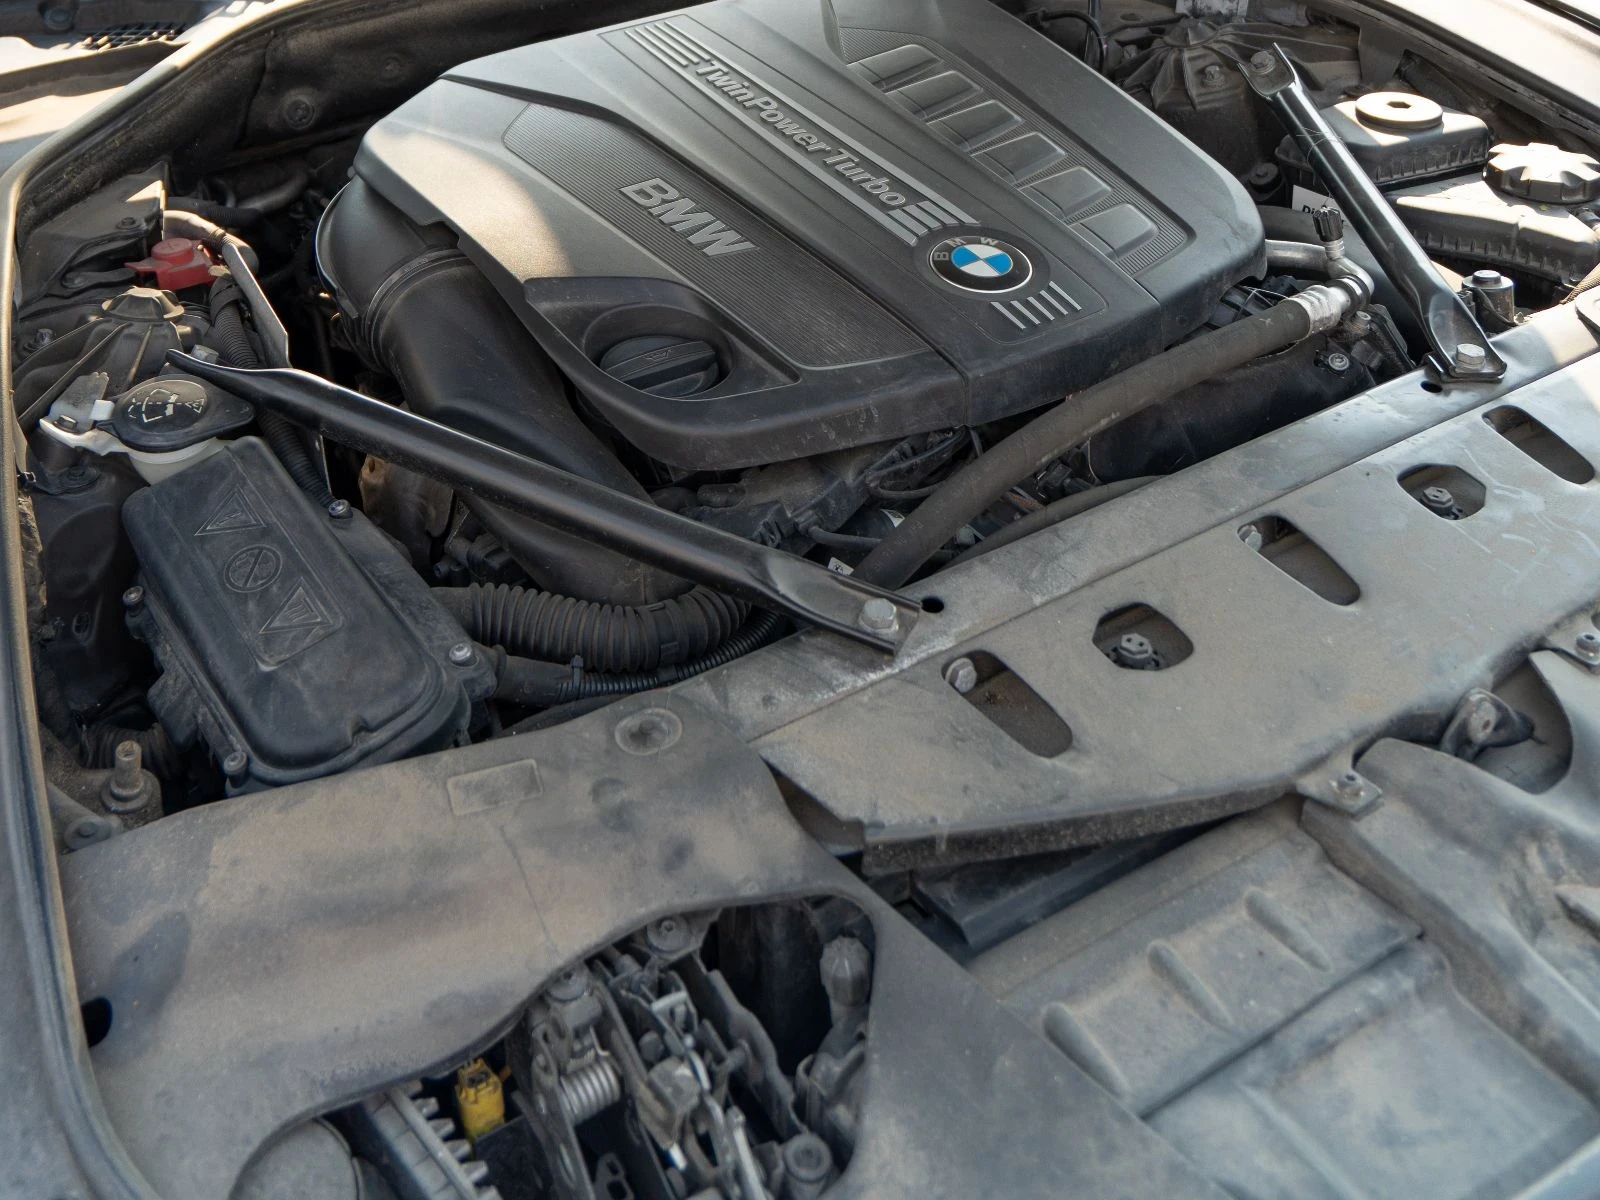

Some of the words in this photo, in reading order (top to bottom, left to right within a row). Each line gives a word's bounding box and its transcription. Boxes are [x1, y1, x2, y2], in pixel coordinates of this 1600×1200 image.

[696, 60, 831, 152] TwinPower
[823, 148, 906, 206] Turbo
[618, 177, 757, 256] BMW
[933, 237, 1001, 261] BMW
